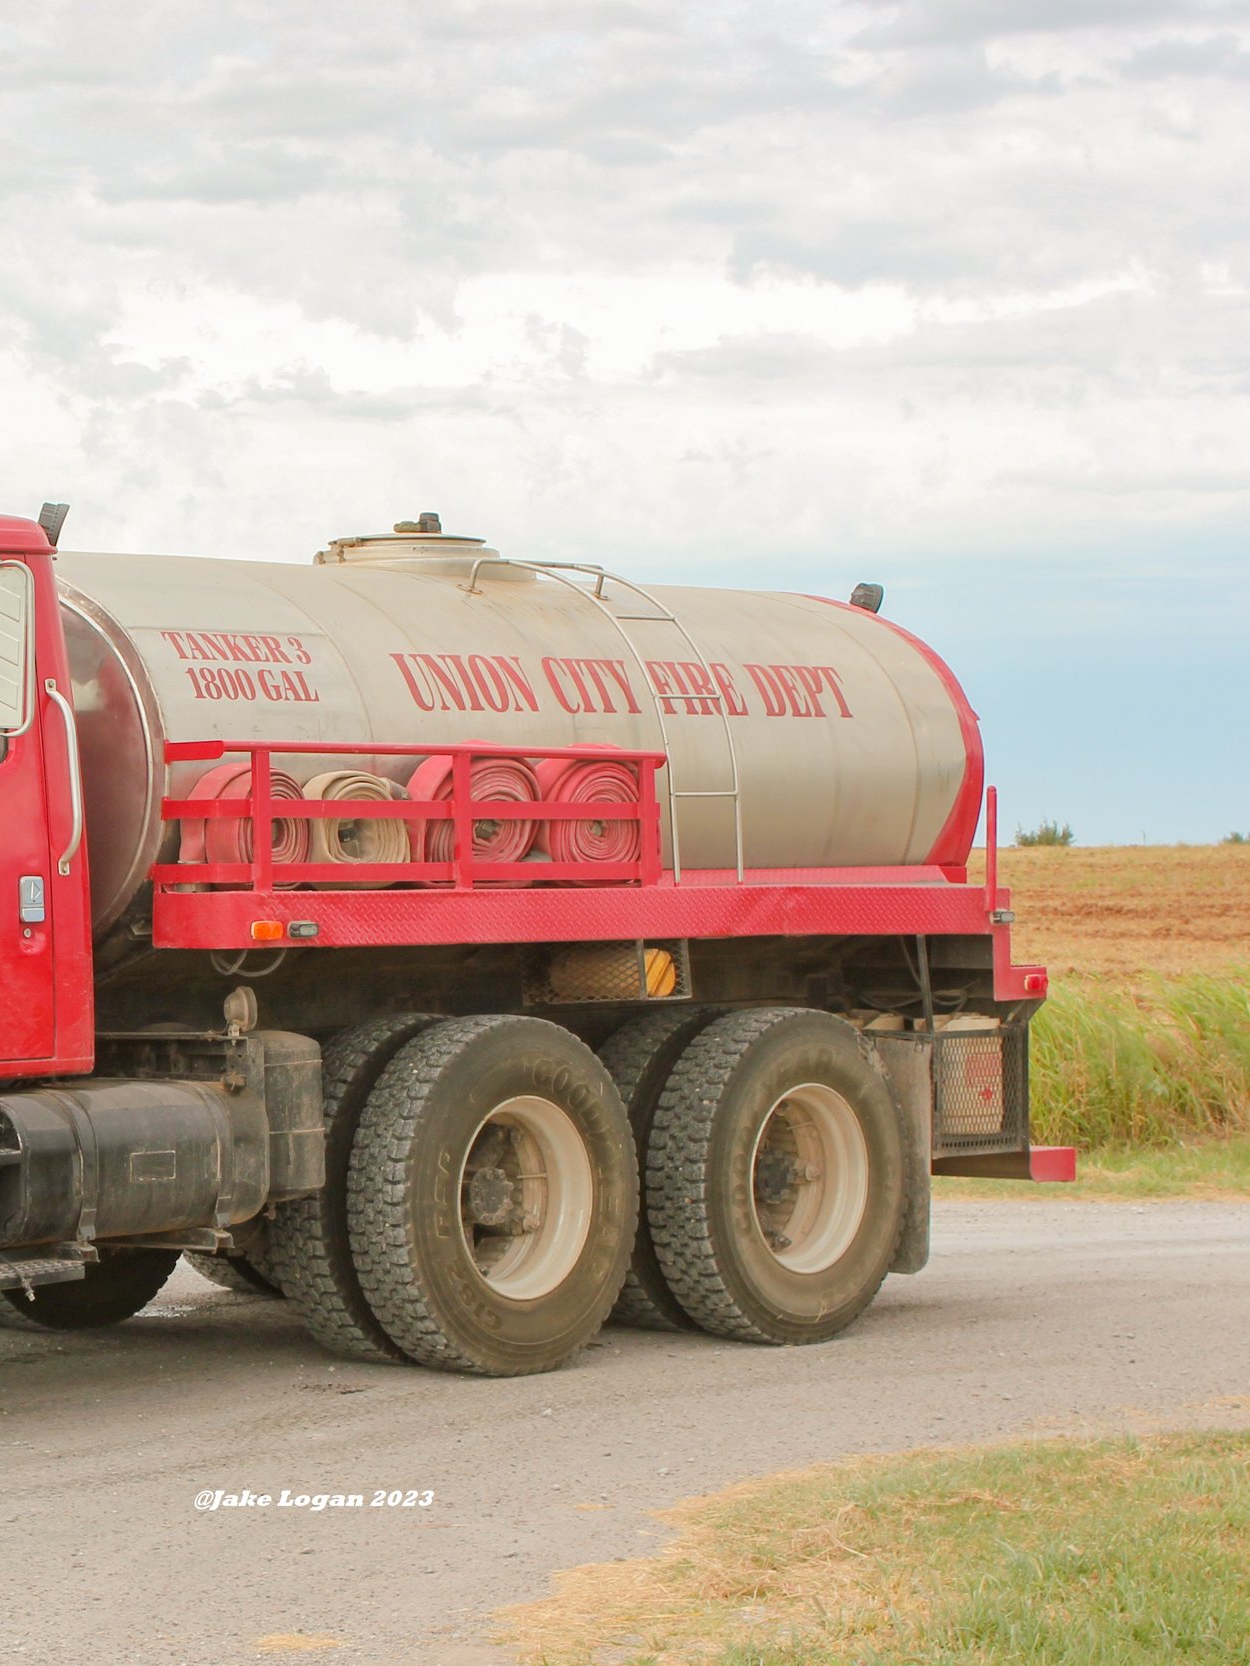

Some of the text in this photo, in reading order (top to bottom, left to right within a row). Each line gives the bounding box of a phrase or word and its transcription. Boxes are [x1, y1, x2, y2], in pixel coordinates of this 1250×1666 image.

[160, 631, 312, 665] TANKER 3
[185, 667, 320, 702] 1800 GAL
[388, 653, 854, 718] UNION CITY FIRE DEPT
